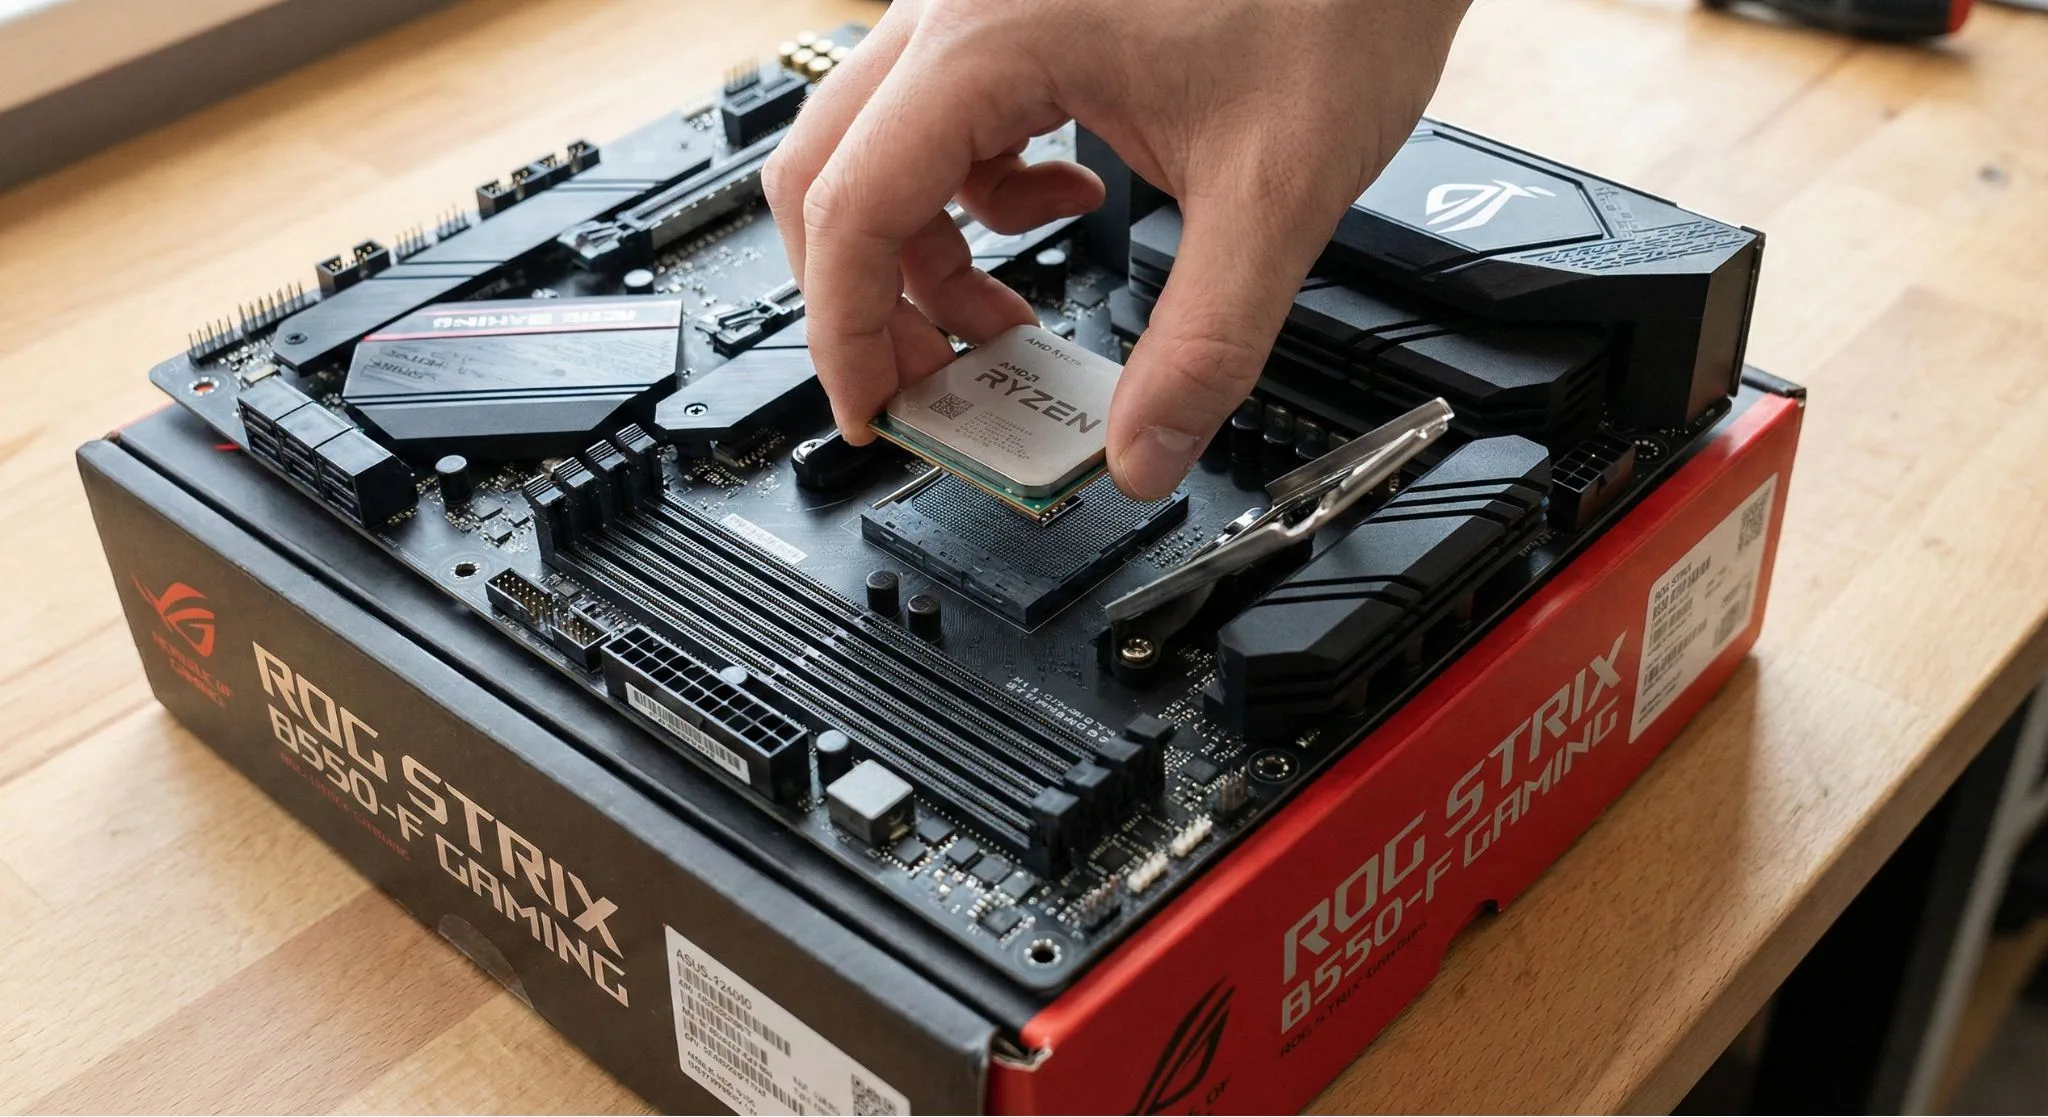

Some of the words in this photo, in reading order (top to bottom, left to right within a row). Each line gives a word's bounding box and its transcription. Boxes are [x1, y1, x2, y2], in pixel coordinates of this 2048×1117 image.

[975, 368, 1102, 434] RYZEN
[1025, 337, 1052, 352] AMD
[252, 641, 388, 783] ROG
[402, 755, 624, 960] STRIX
[267, 703, 424, 845] B550-F
[435, 834, 630, 1008] GAMING
[1280, 850, 1456, 1035] B550-F
[1462, 696, 1620, 868] GAMING
[1282, 811, 1427, 985] ROG
[1444, 630, 1628, 839] STRIX
